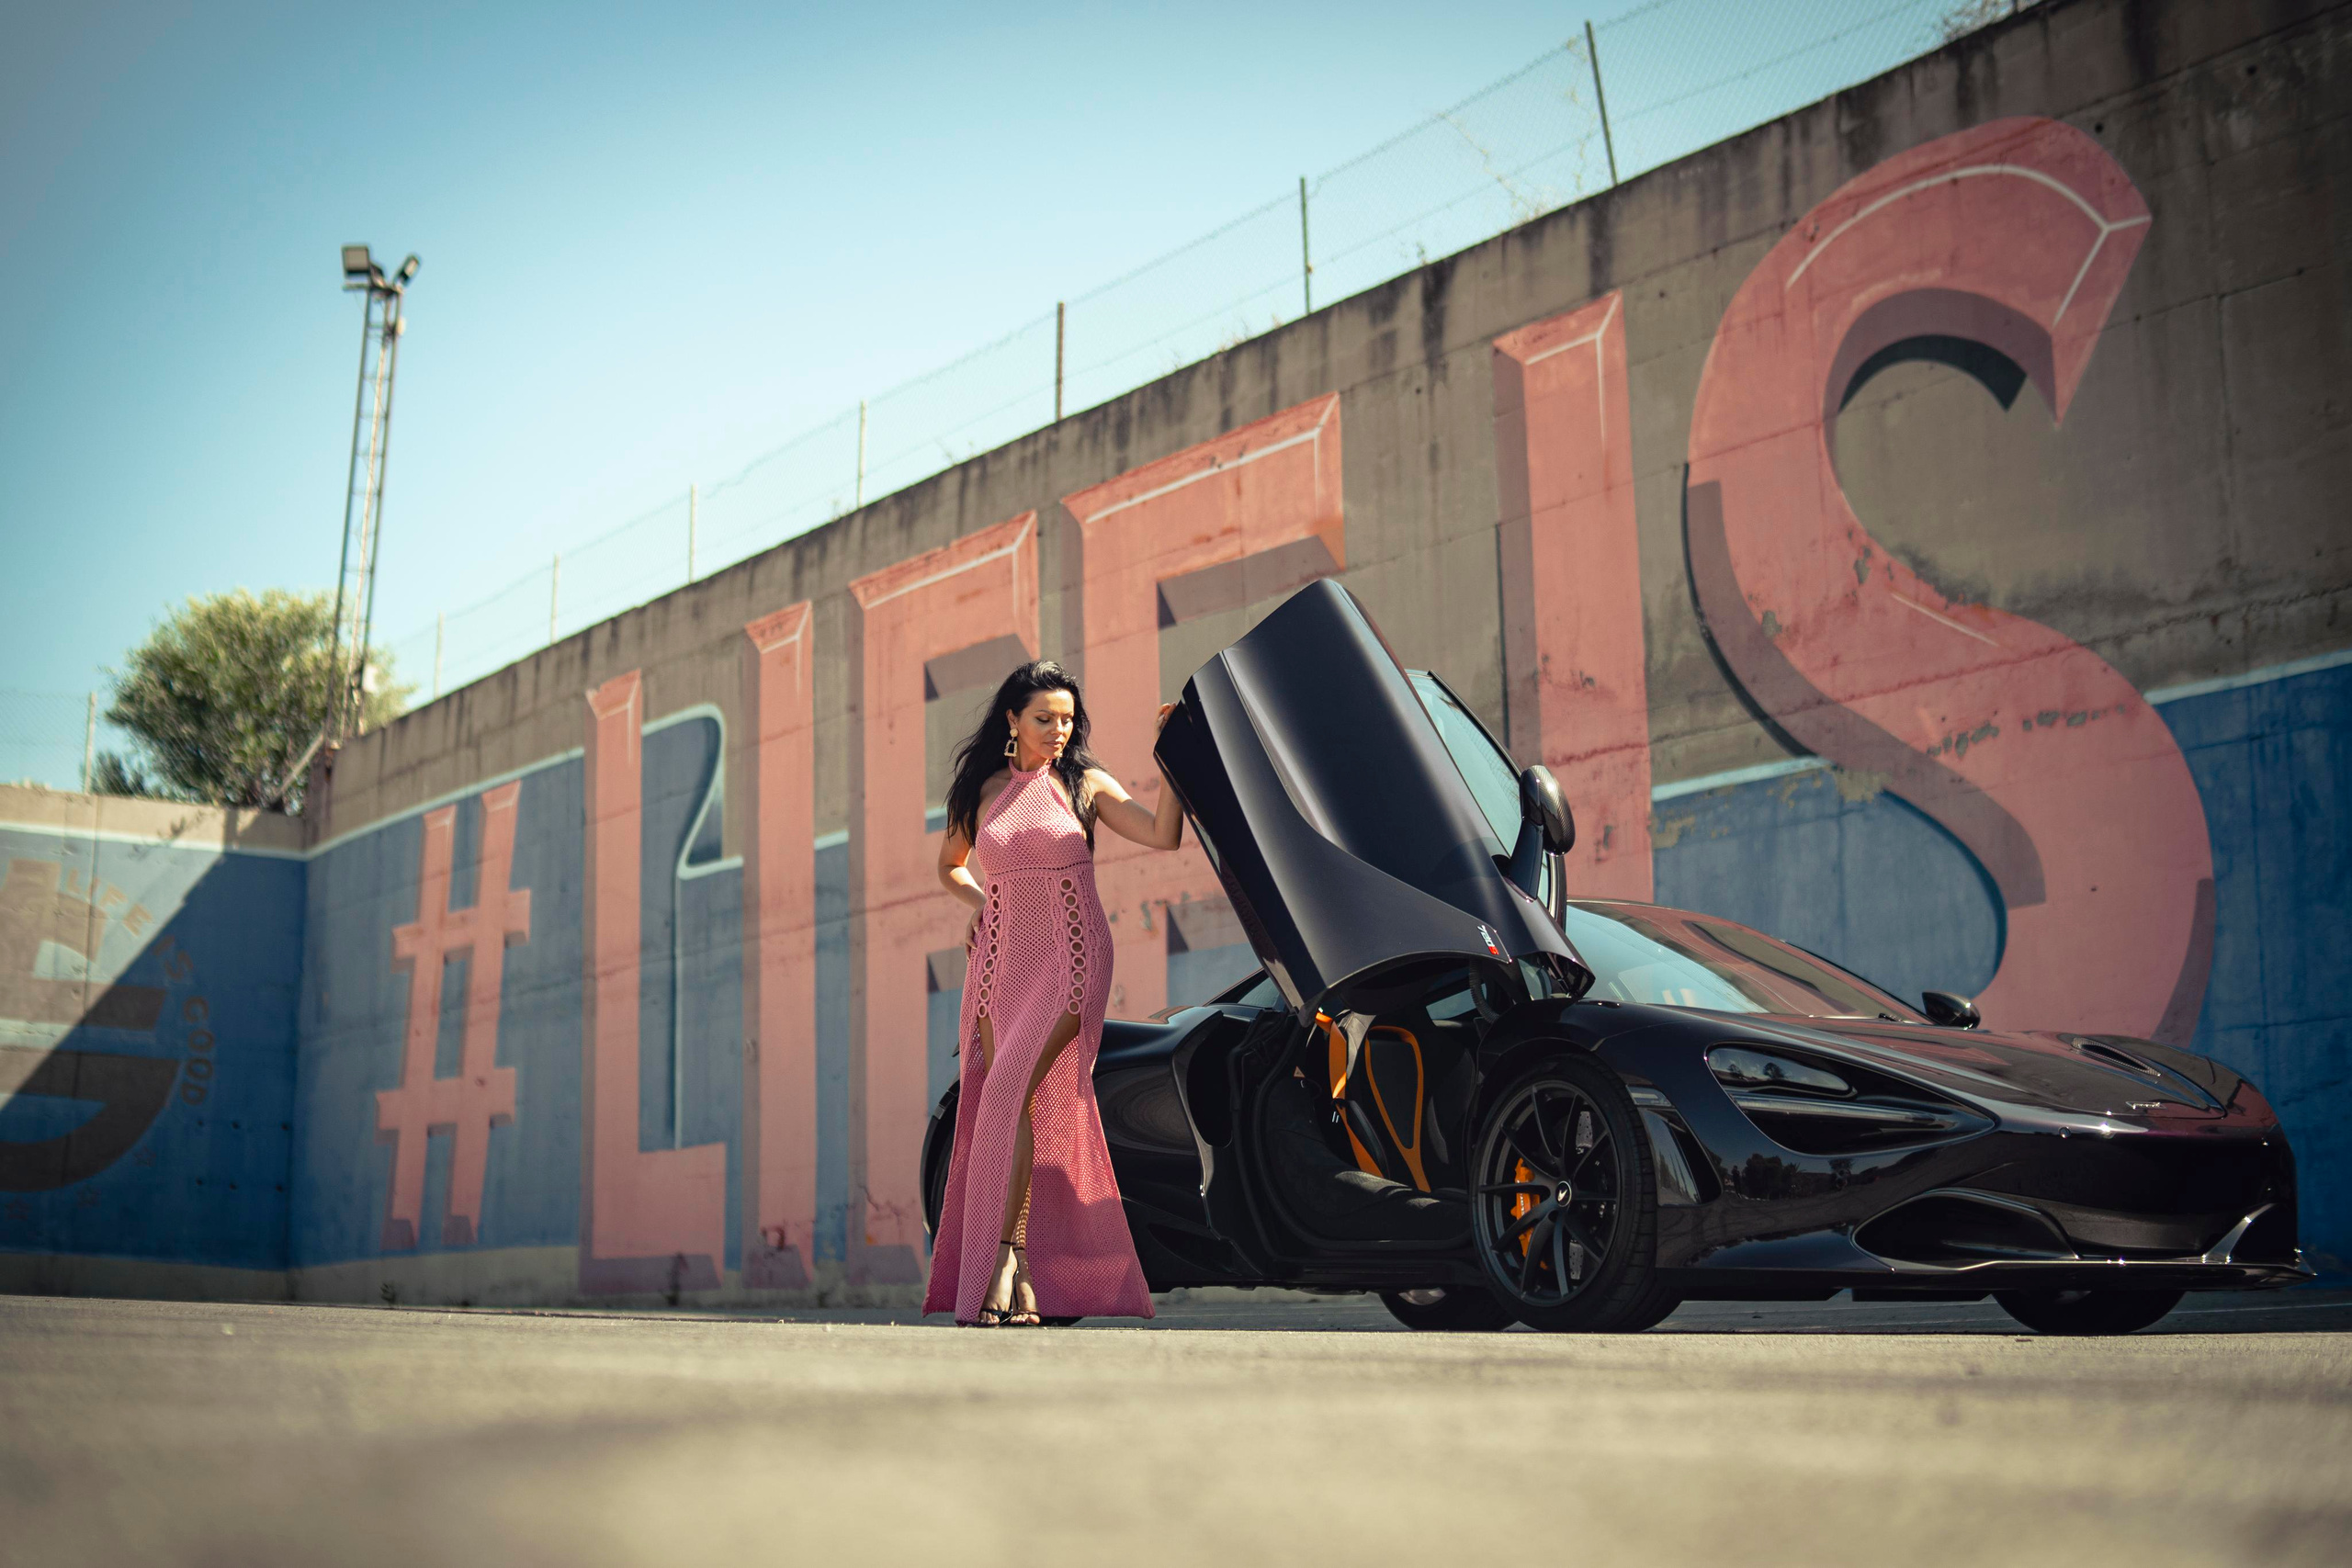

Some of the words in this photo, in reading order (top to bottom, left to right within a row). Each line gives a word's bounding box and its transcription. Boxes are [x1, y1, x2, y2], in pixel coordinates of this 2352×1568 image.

[1492, 116, 2217, 1047] IS
[66, 868, 153, 938] LIFE
[153, 935, 194, 982] IS
[181, 995, 215, 1106] GOOD
